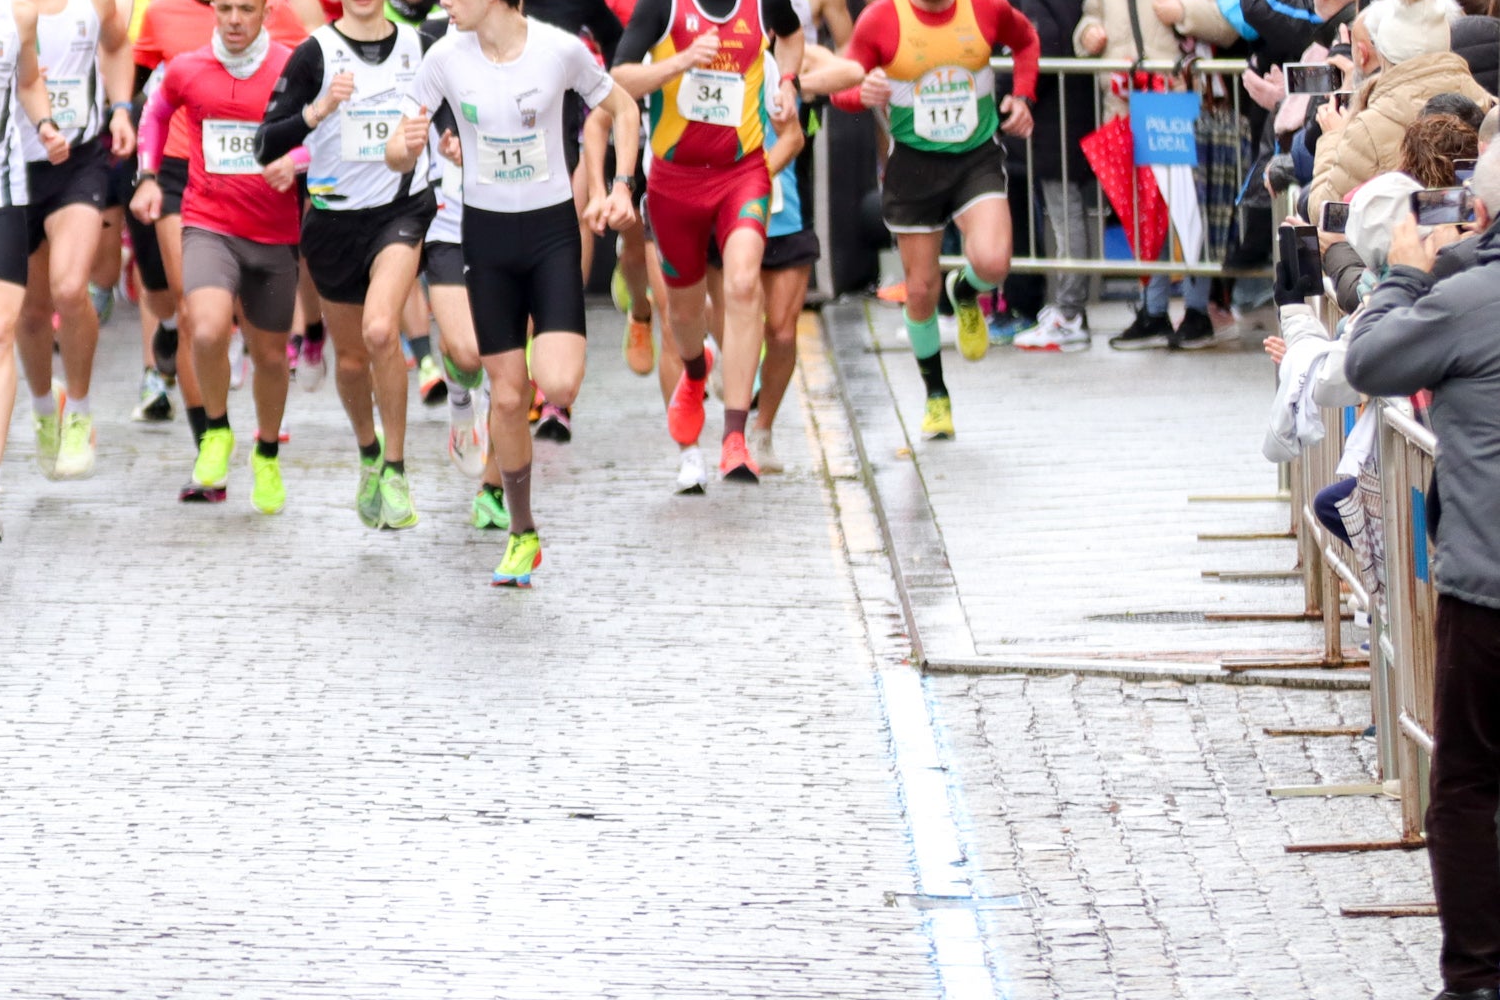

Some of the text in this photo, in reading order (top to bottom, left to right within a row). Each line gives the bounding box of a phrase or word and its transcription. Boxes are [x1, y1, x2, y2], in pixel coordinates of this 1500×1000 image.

[697, 85, 723, 102] 34
[929, 107, 964, 124] 117
[363, 121, 389, 140] 19
[218, 136, 256, 153] 188
[498, 149, 522, 165] 11
